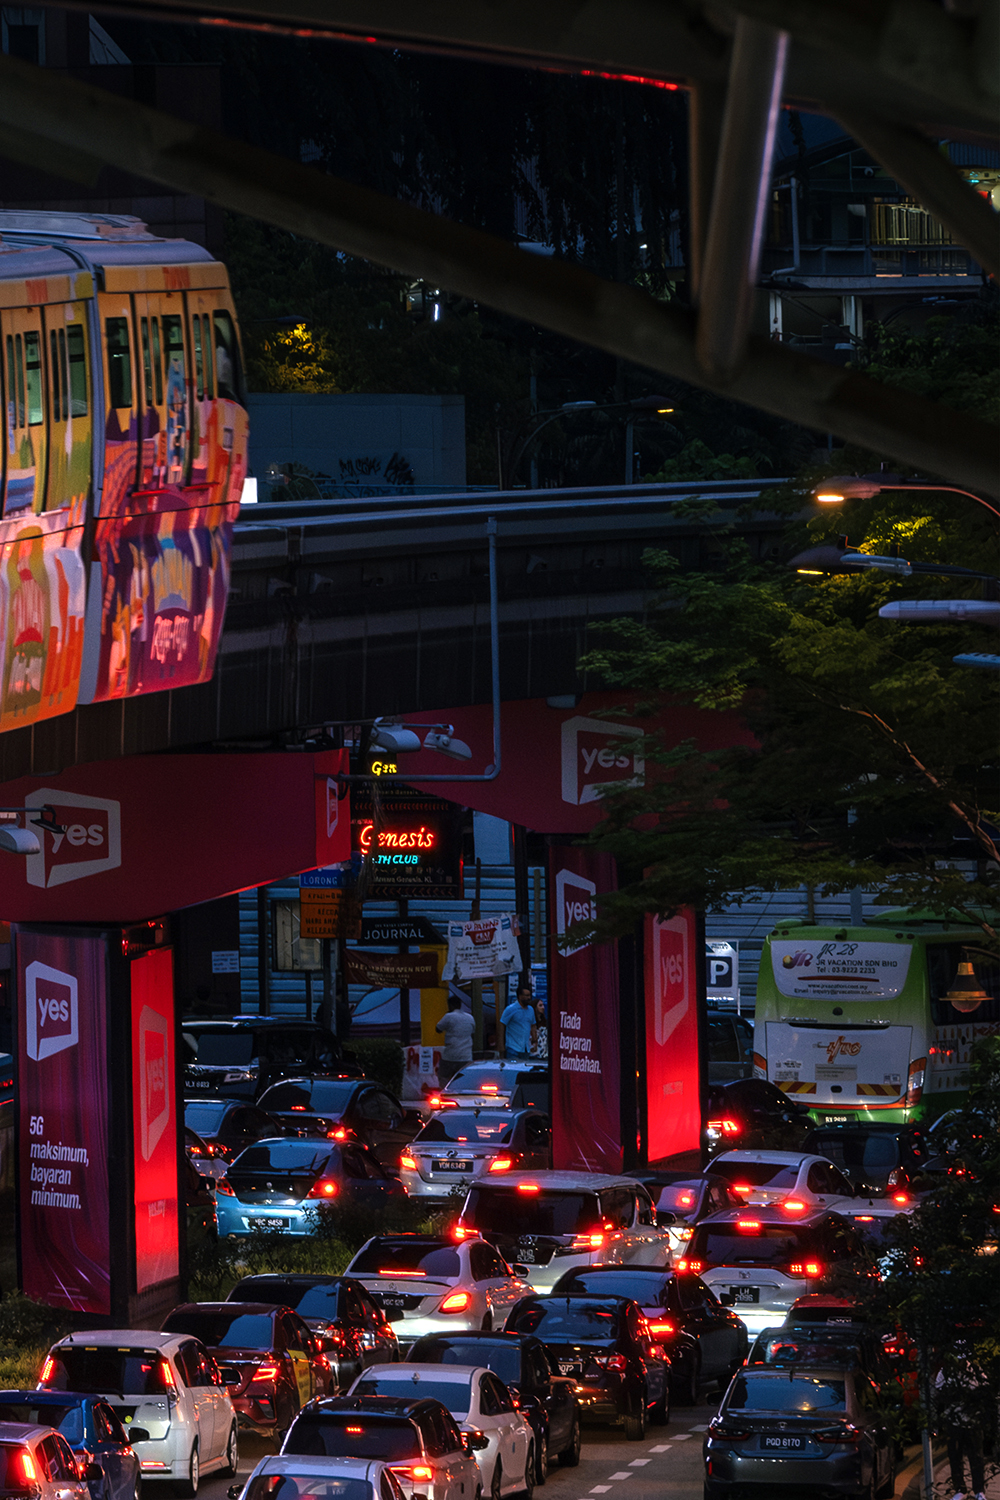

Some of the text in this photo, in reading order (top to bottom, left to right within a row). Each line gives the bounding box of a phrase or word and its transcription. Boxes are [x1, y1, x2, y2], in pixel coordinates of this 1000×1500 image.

[392, 854, 419, 865] CLUB
[566, 900, 590, 927] yes
[364, 929, 425, 940] JOURNAL
[815, 959, 827, 967] JR
[827, 959, 864, 967] VACATION
[38, 998, 69, 1028] yes
[559, 1010, 582, 1031] Tiada
[559, 1031, 592, 1055] bayaran
[559, 1053, 602, 1075] tambahan.
[29, 1115, 44, 1136] 5G
[29, 1140, 90, 1168] maksimum,
[30, 1162, 72, 1187] bayaran
[30, 1187, 82, 1210] minimum.
[782, 1438, 801, 1448] 6170
